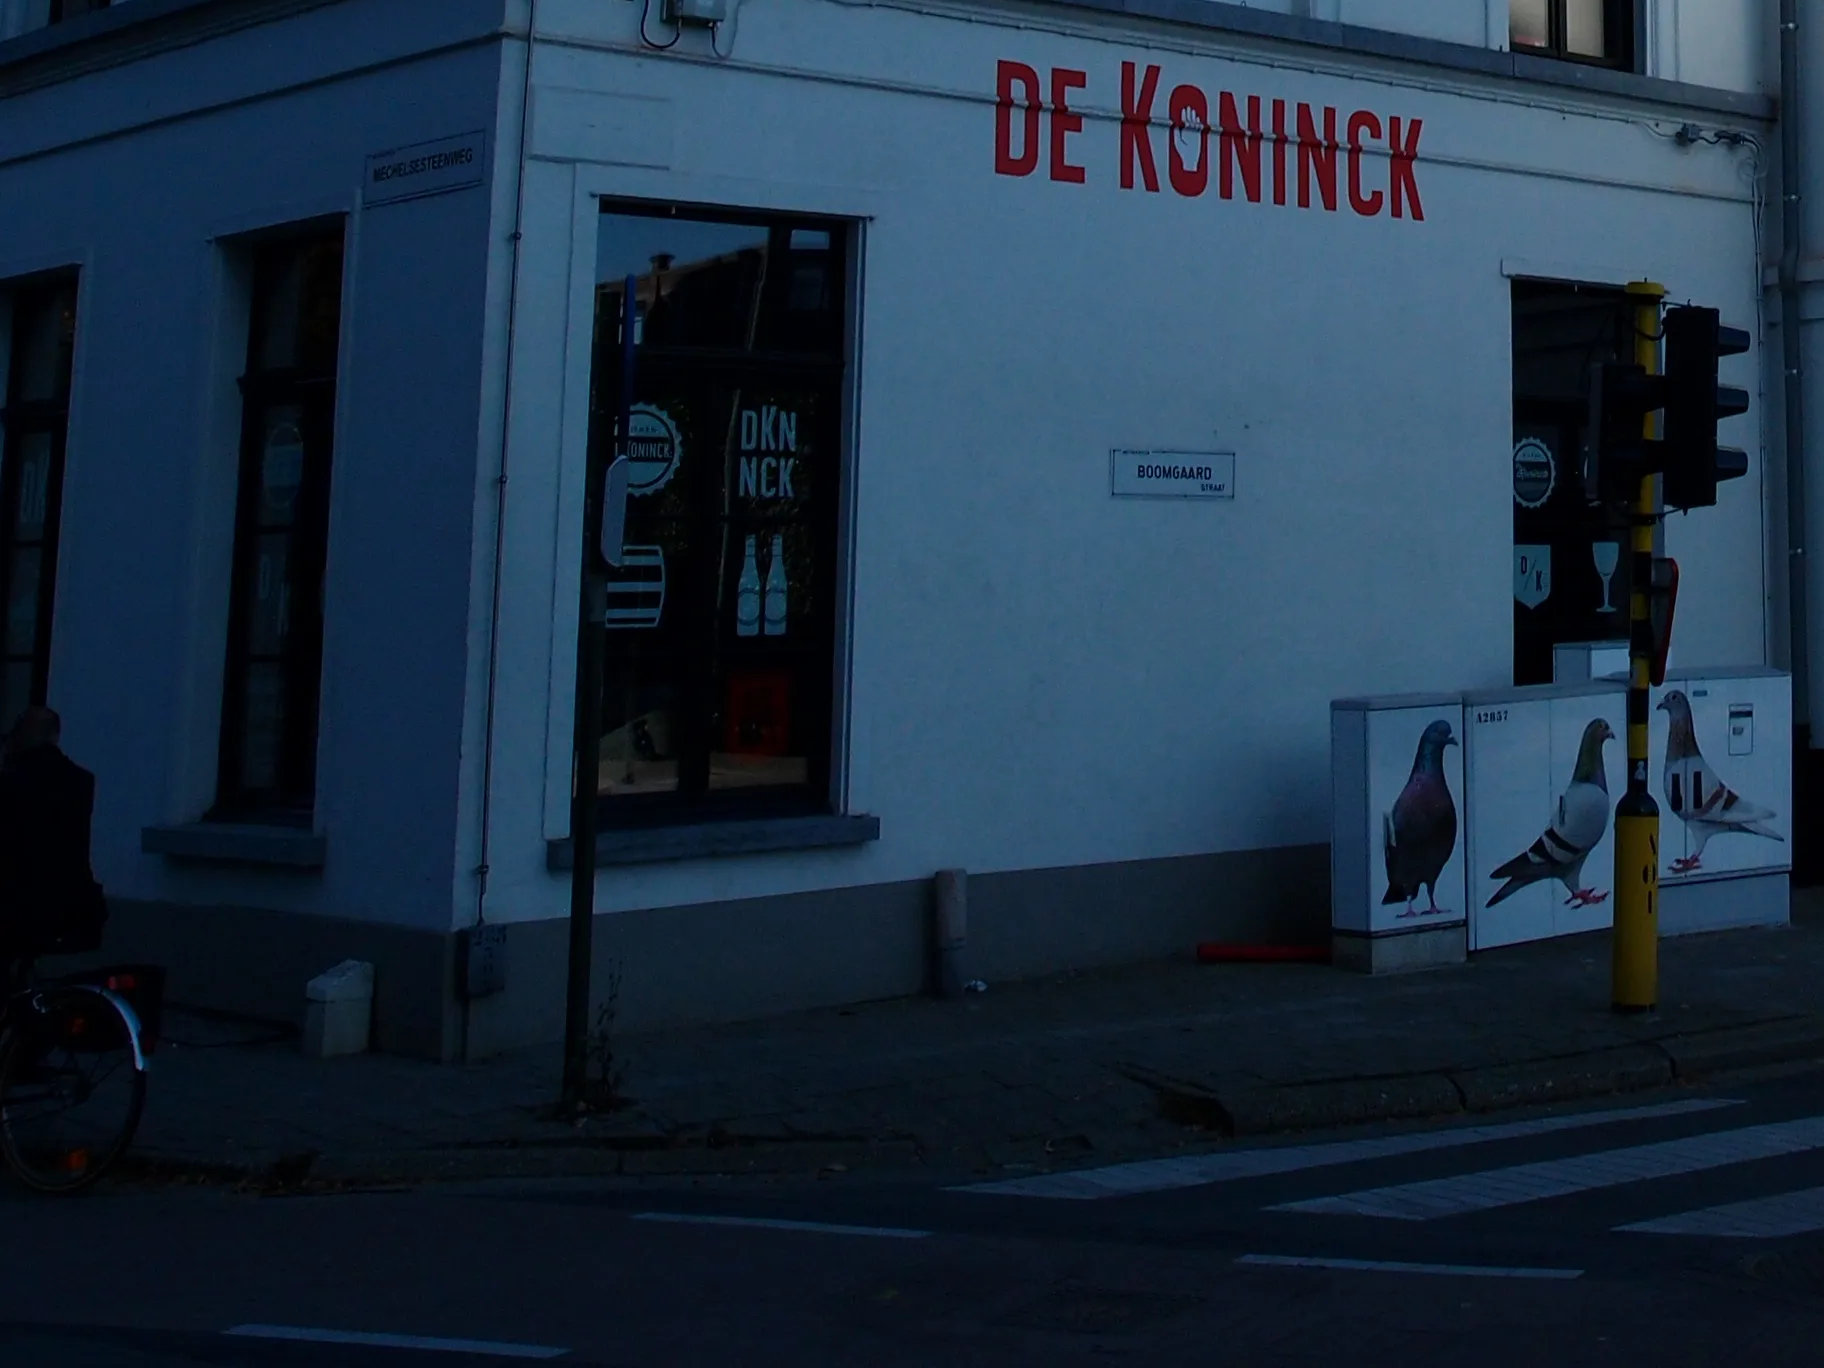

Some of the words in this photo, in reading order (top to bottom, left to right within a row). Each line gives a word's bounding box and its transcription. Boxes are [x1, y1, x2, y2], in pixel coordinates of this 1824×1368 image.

[995, 60, 1086, 184] DE
[1120, 61, 1425, 221] KONINCK
[373, 147, 474, 182] MECHELSESTEENWEG
[741, 404, 798, 453] DKN
[738, 455, 796, 499] NCK
[1137, 465, 1212, 480] BOOMGAARD
[1201, 483, 1225, 492] STRAAT
